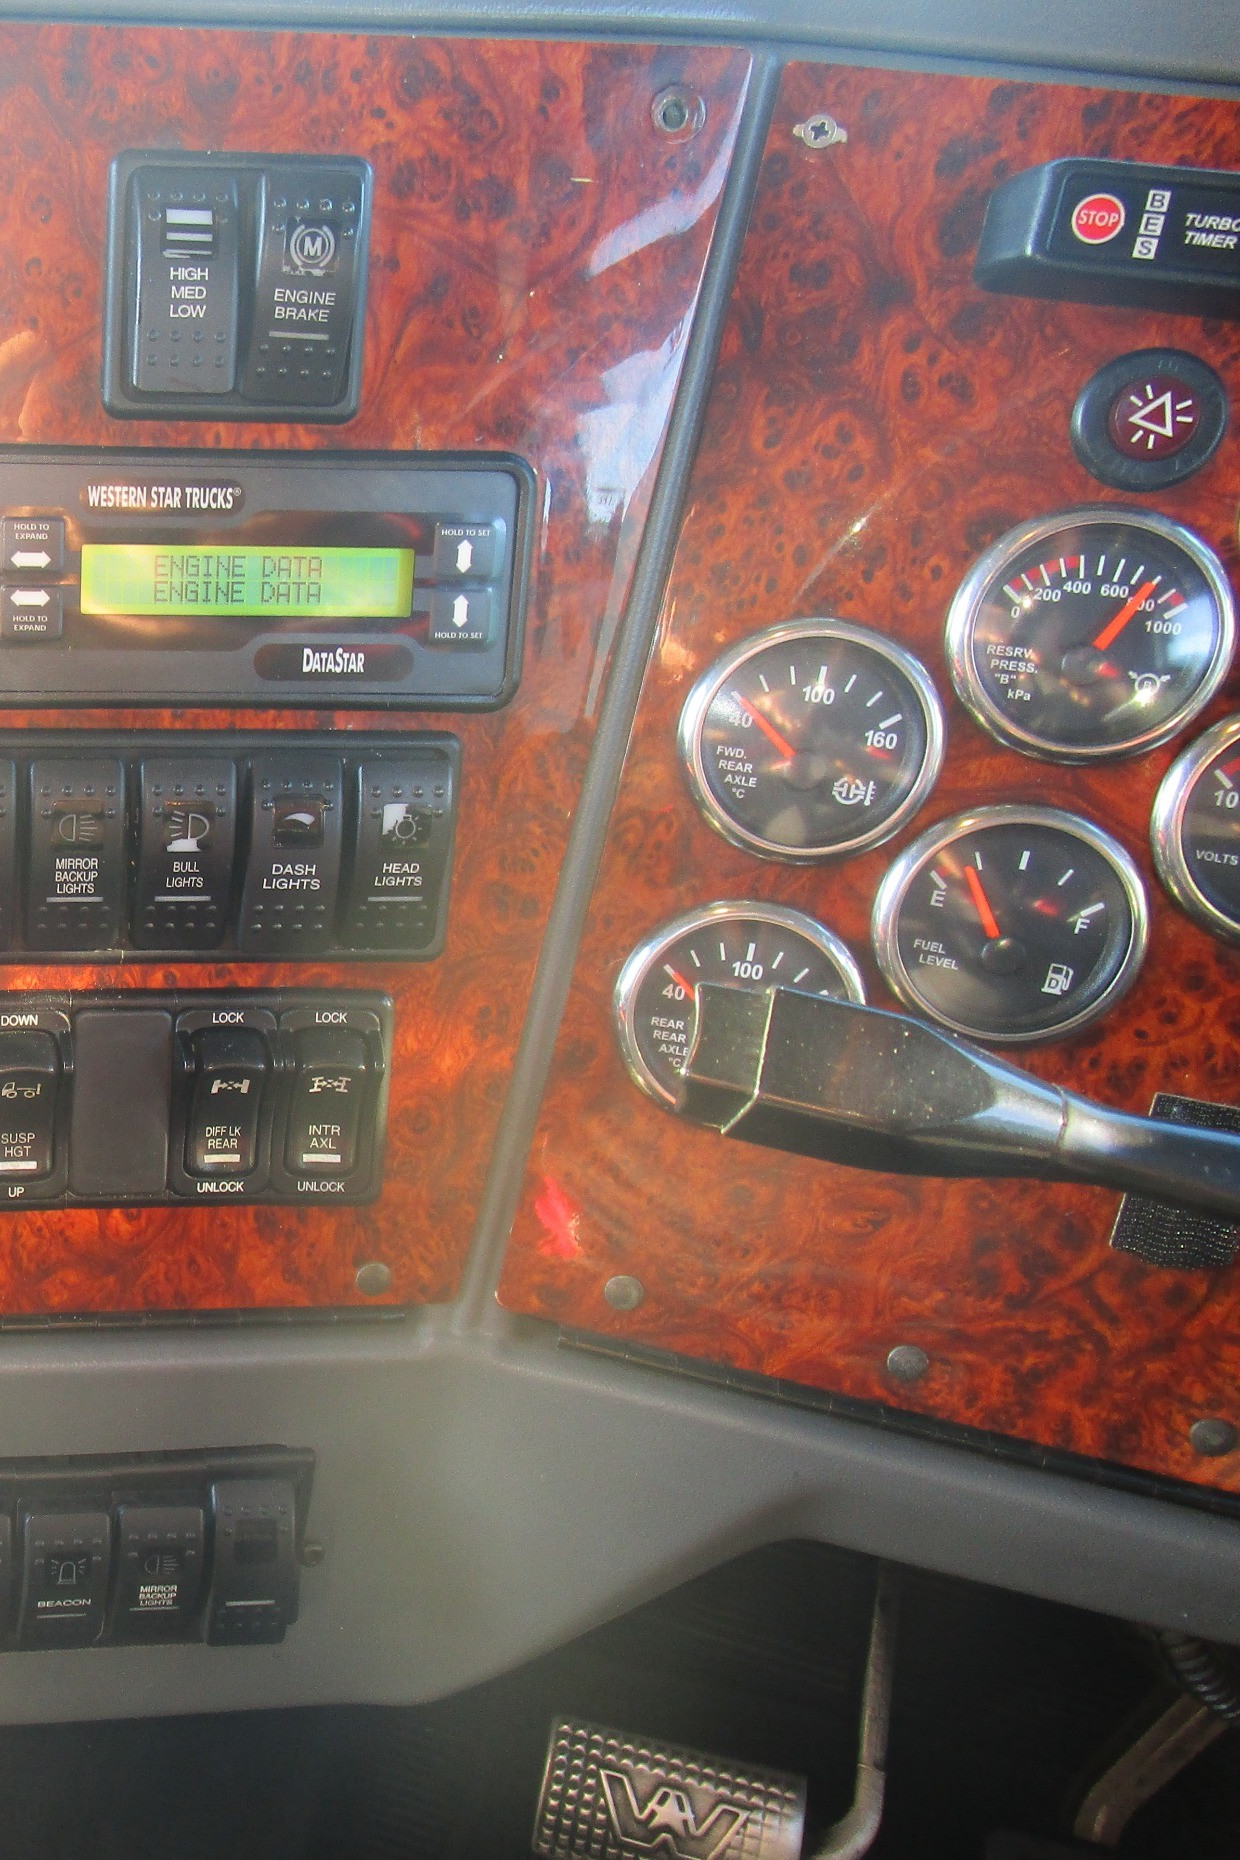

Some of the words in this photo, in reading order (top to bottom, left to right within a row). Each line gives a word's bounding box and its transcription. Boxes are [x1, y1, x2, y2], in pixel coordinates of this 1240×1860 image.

[1078, 208, 1119, 227] STOP
[1184, 230, 1238, 249] TIMER
[304, 237, 322, 256] M
[170, 267, 208, 281] HIGH
[171, 286, 206, 299] MED
[274, 289, 336, 305] ENGINE
[169, 305, 206, 318] LOW
[274, 307, 329, 322] BRAKE
[88, 486, 147, 508] WESTERN
[151, 487, 181, 508] STAR
[155, 555, 246, 578] ENGINE
[263, 556, 322, 578] DATA
[154, 581, 245, 604] ENGINE
[261, 581, 321, 604] DATA
[1063, 581, 1091, 594] 400
[1101, 584, 1129, 598] 600
[1033, 588, 1061, 602] 200
[1011, 607, 1020, 619] 0
[1145, 621, 1181, 635] 1000
[990, 659, 1038, 673] PRESS.
[802, 685, 835, 704] 100
[1007, 689, 1031, 701] kPa
[729, 712, 753, 728] 40
[865, 730, 897, 749] 160
[717, 745, 747, 759] FWD.
[718, 760, 752, 773] REAR
[724, 774, 757, 788] AXLE
[1214, 789, 1238, 809] 10
[55, 858, 98, 870] MIRROR
[1196, 849, 1238, 866] VOLTS
[173, 862, 199, 872] BULL
[272, 864, 316, 876] DASH
[383, 862, 420, 875] HEAD
[55, 871, 98, 882] BACKUP
[166, 877, 203, 888] LIGHTS
[374, 875, 423, 888] LIGHTS
[56, 883, 95, 894] LIGHTS
[262, 877, 322, 891] LIGHTS
[930, 890, 947, 907] E
[1074, 918, 1090, 934] F
[913, 939, 946, 954] FUEL
[919, 953, 958, 970] LEVEL
[732, 961, 763, 980] 100
[662, 984, 685, 1001] 40
[0, 1014, 38, 1027] DOWN
[212, 1012, 244, 1024] LOCK
[315, 1012, 348, 1024] LOCK
[651, 1017, 684, 1030] REAR
[653, 1030, 687, 1043] REAR
[659, 1044, 689, 1057] AXLE
[205, 1126, 226, 1138] DIFF
[228, 1126, 241, 1137] LK
[308, 1125, 341, 1137] INTR
[1, 1133, 36, 1145] SUSP
[208, 1138, 239, 1150] REAR
[310, 1137, 337, 1149] AXL
[4, 1145, 32, 1157] HGT
[8, 1186, 25, 1198] UP
[196, 1180, 244, 1193] UNLOCK
[297, 1181, 345, 1193] UNLOCK
[140, 1585, 177, 1593] MIRROR
[37, 1599, 91, 1608] BEACON
